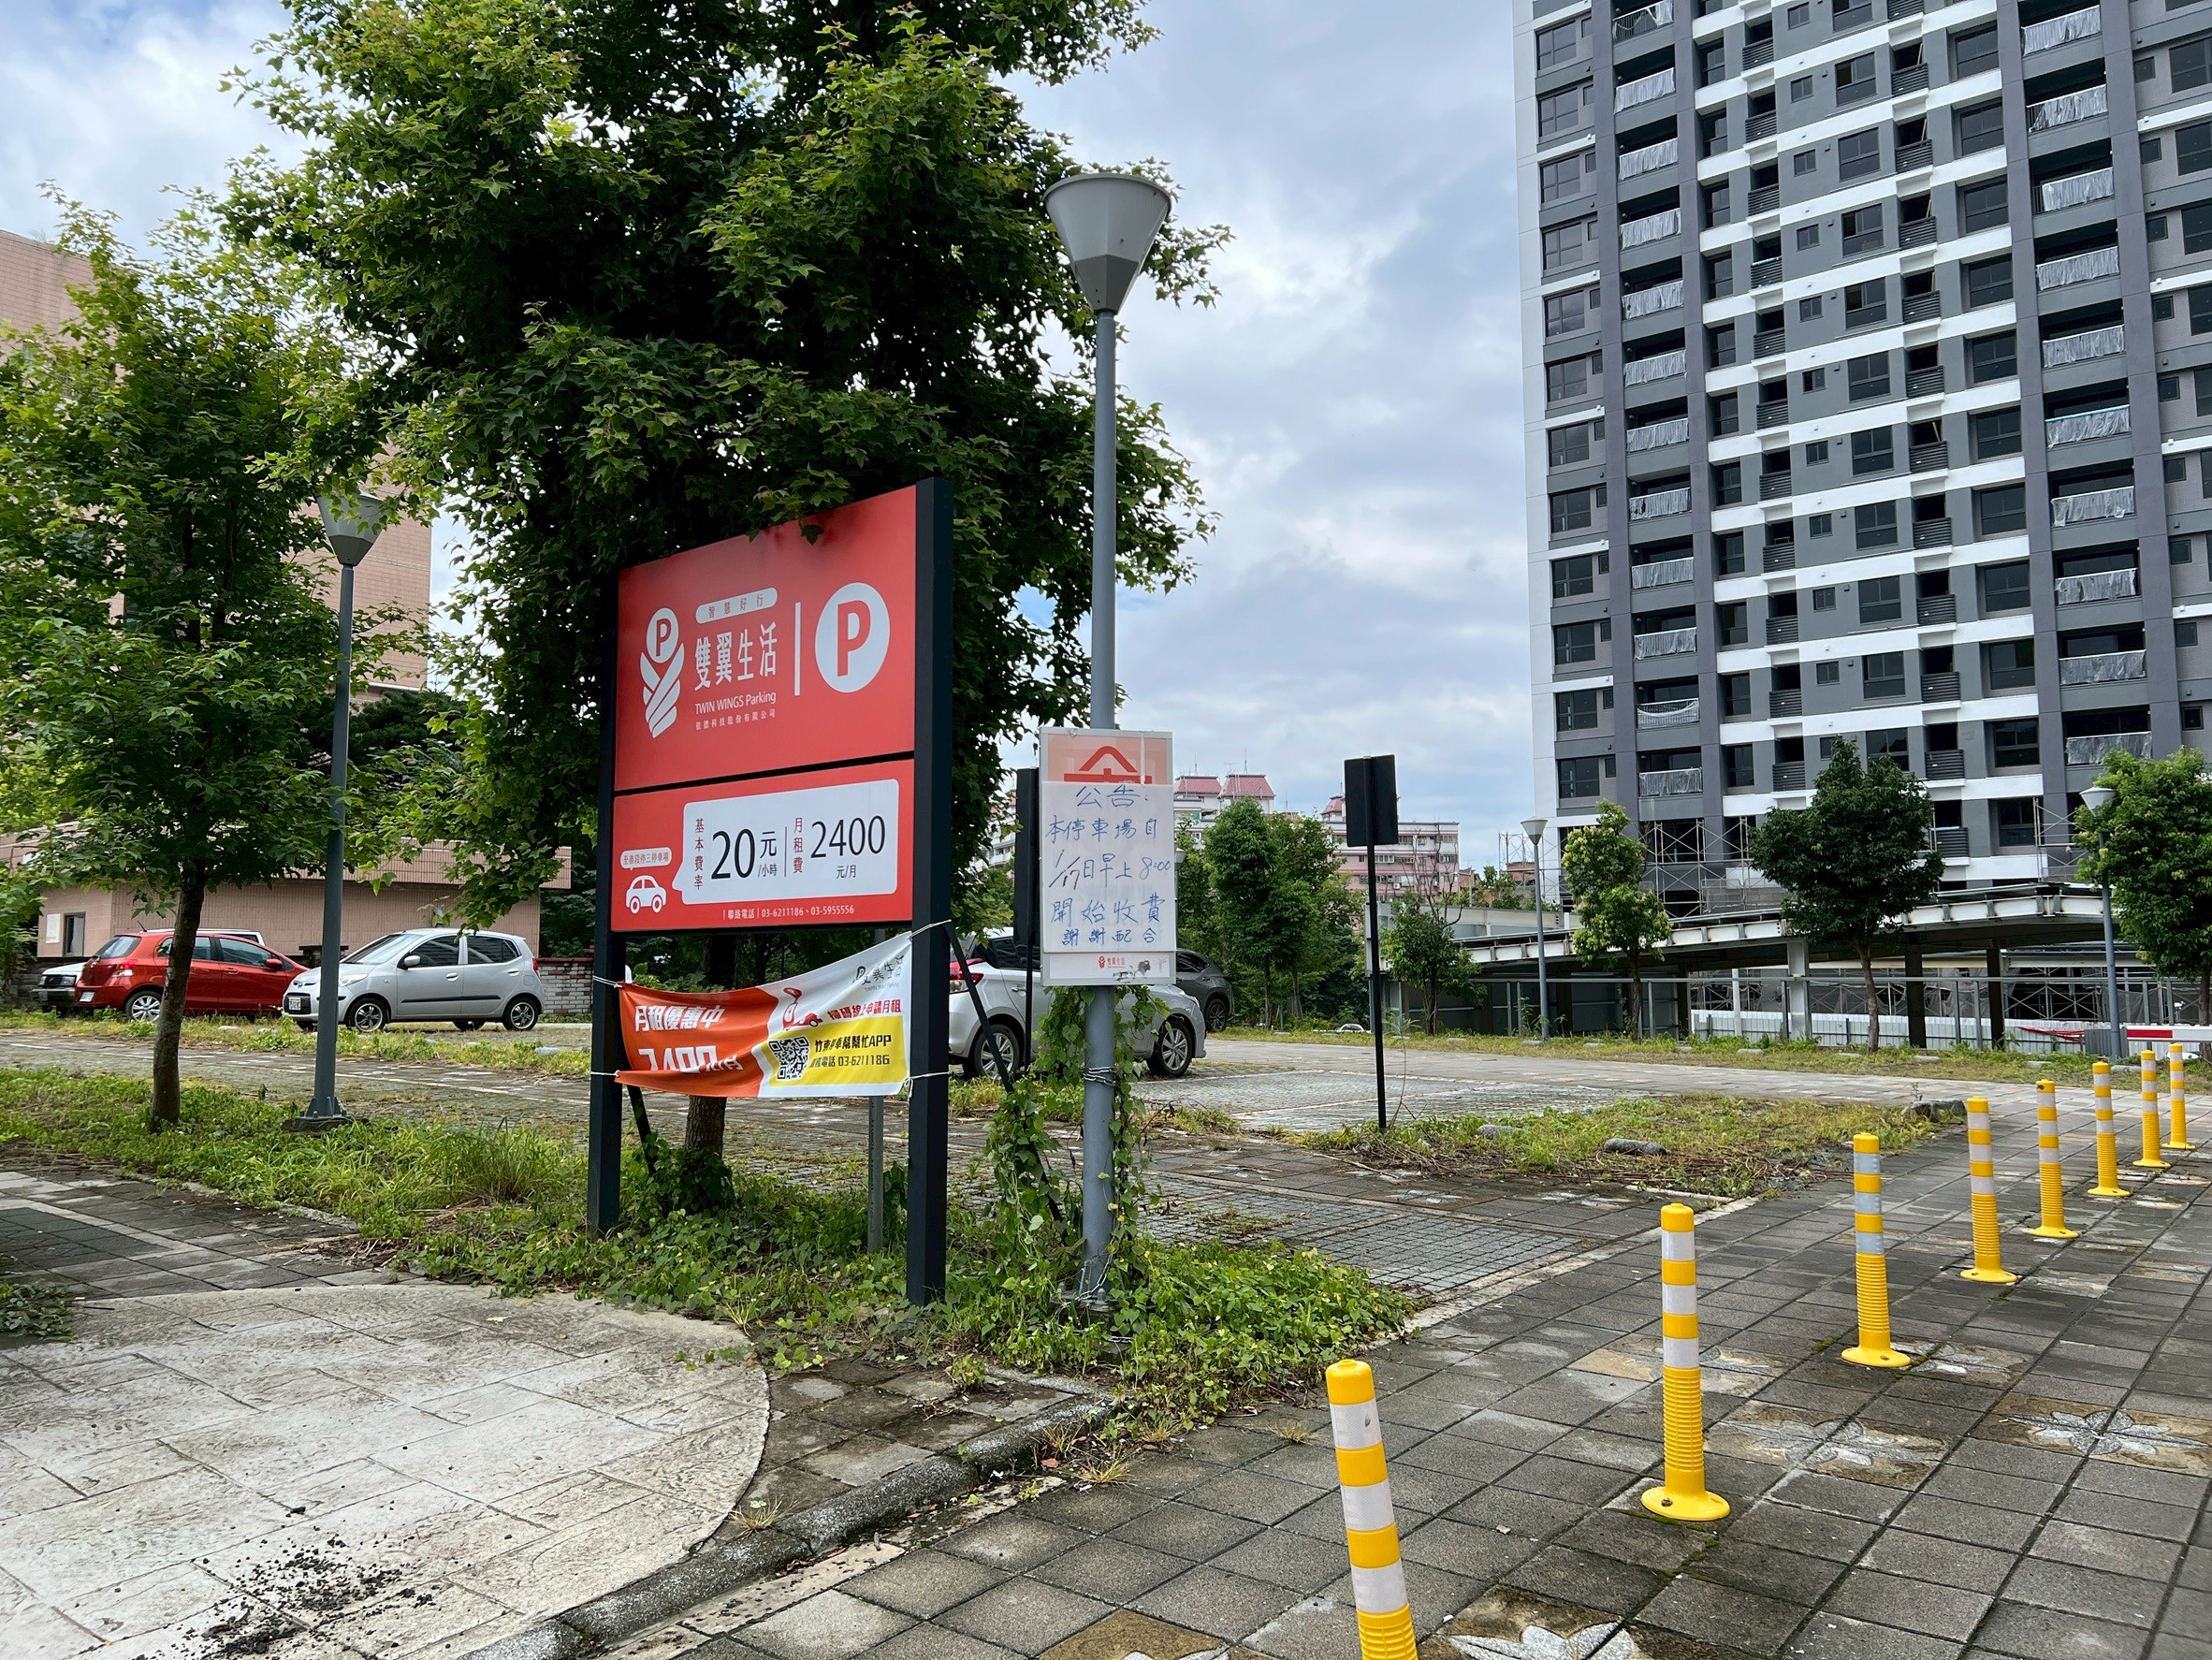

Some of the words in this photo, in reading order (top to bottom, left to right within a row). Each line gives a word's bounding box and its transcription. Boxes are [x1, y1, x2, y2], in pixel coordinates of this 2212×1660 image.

[708, 593, 764, 619] 智慧好行
[656, 619, 672, 657] P
[837, 600, 871, 677] P
[694, 621, 778, 692] 雙翼生活
[695, 700, 715, 715] TWIN
[717, 695, 744, 711] WINGS
[746, 692, 777, 706] Parking
[793, 817, 804, 874] 月租費
[810, 815, 885, 859] 2400
[1045, 815, 1157, 844] 本停車場自
[694, 817, 705, 890] 基本費率
[711, 828, 756, 880] 20
[760, 831, 777, 859] 元
[757, 864, 778, 878] /小時
[837, 865, 857, 880] 元/月
[1050, 892, 1166, 927] 開始收費
[1061, 927, 1157, 947] 謝謝配合
[634, 1005, 725, 1031] 月租優惠中
[838, 1055, 890, 1066] 03-6211186
